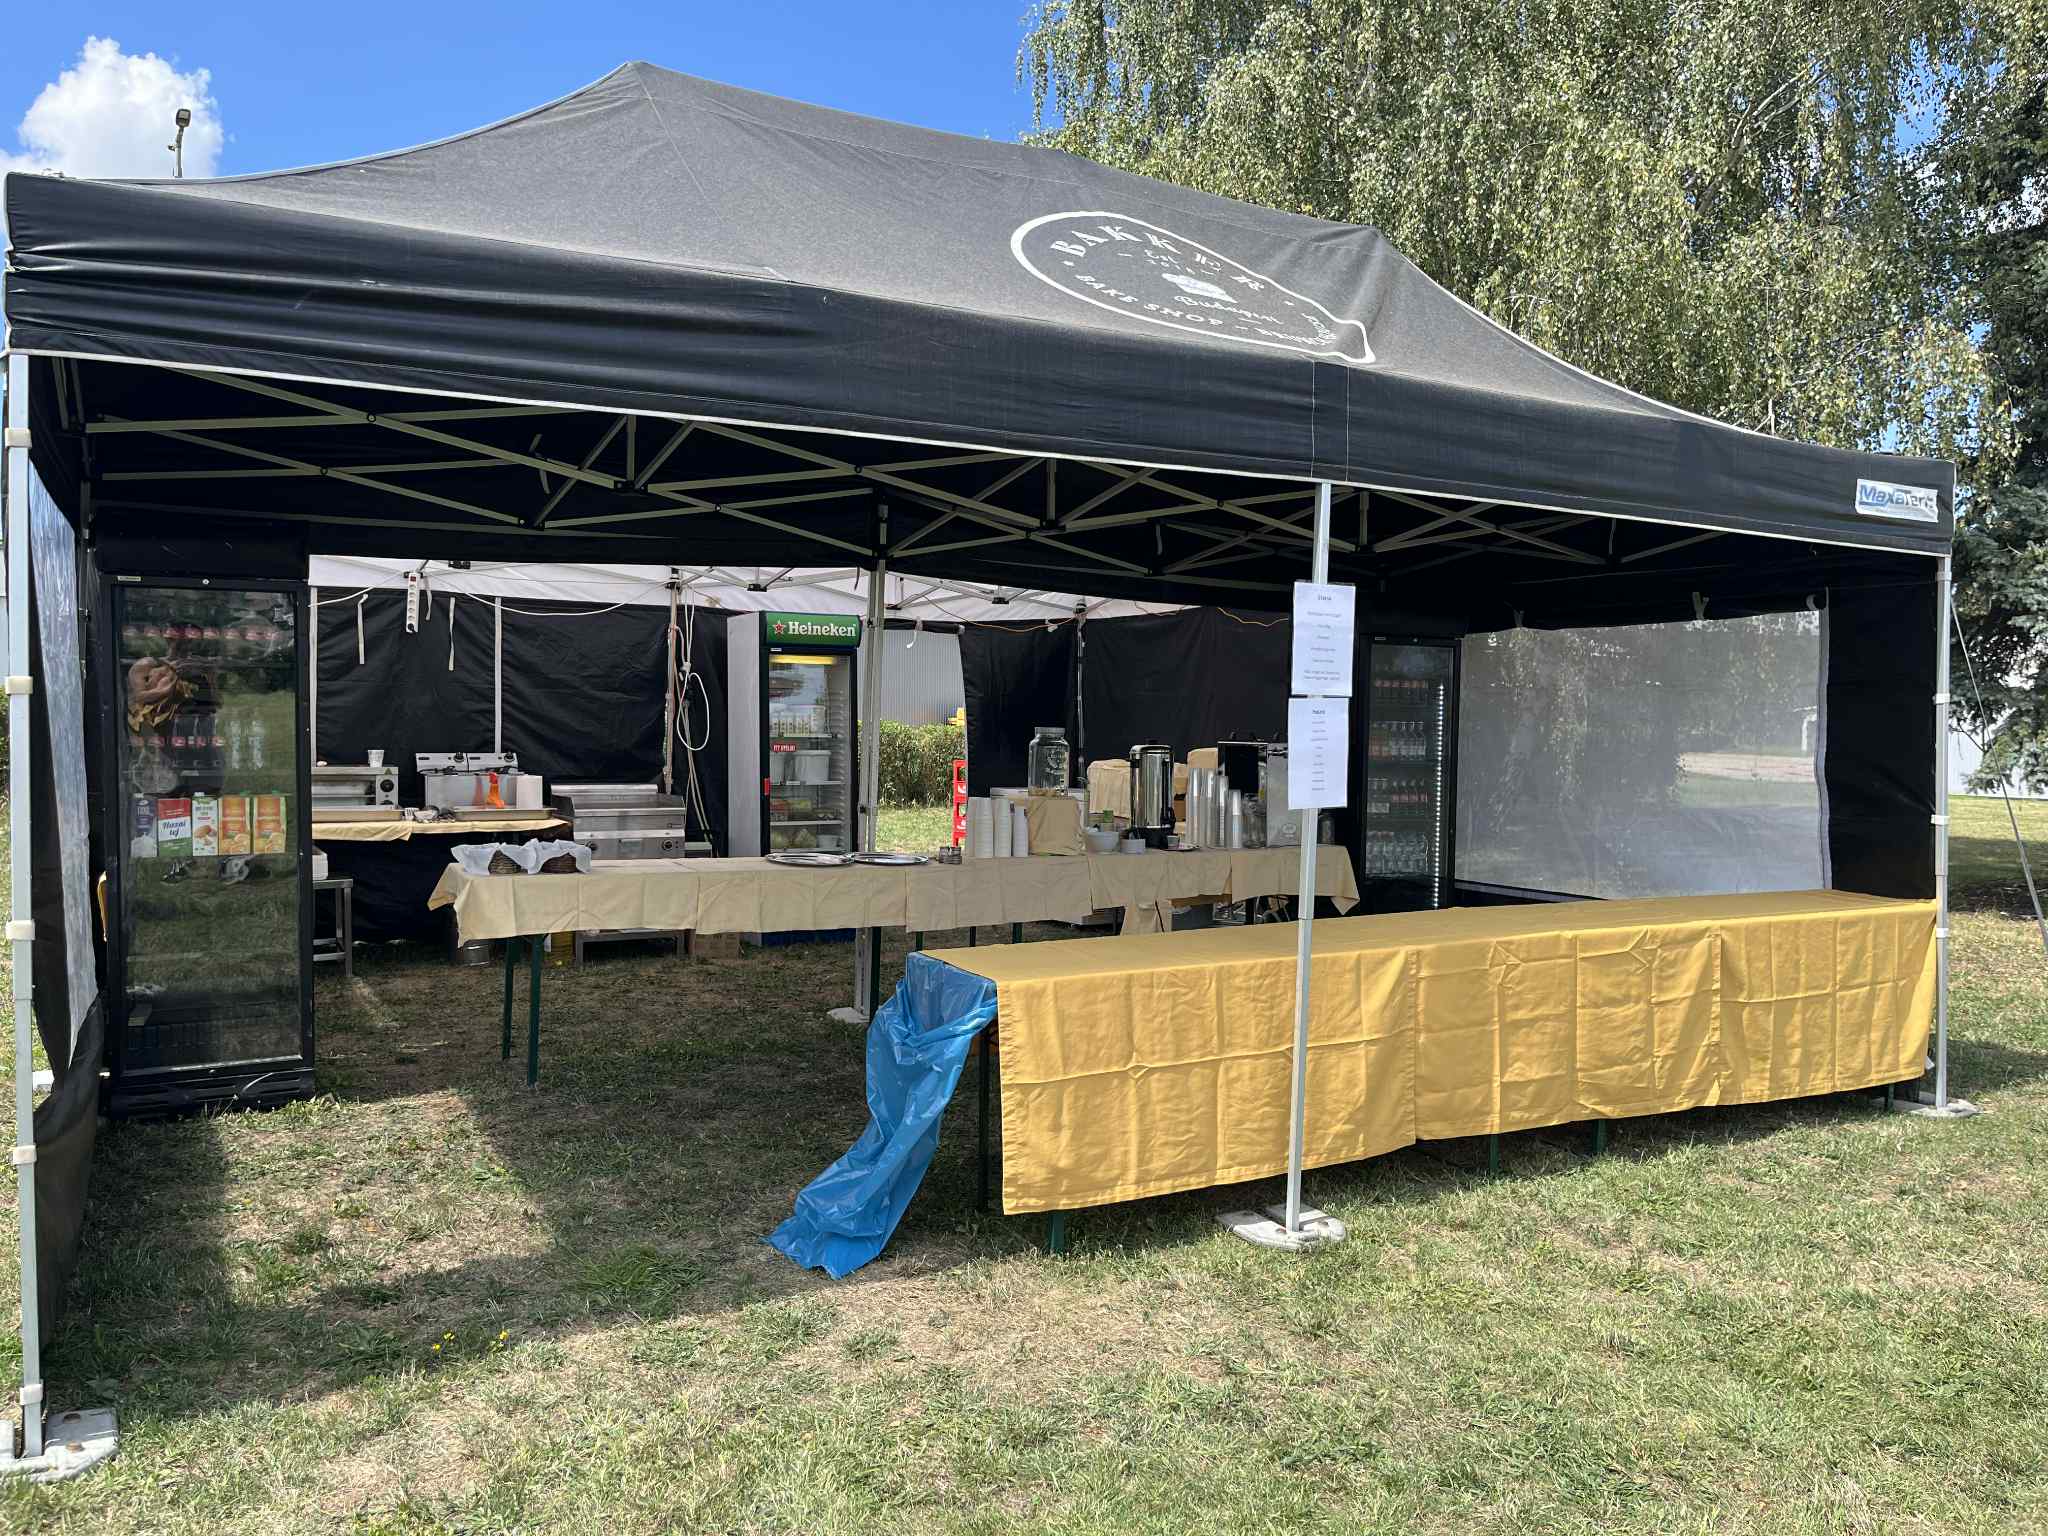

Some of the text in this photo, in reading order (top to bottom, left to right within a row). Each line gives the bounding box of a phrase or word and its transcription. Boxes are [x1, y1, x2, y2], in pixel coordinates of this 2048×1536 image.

[1049, 225, 1265, 291] BAKKER
[1074, 274, 1224, 326] BAKE SHOP
[788, 621, 856, 637] Heineken
